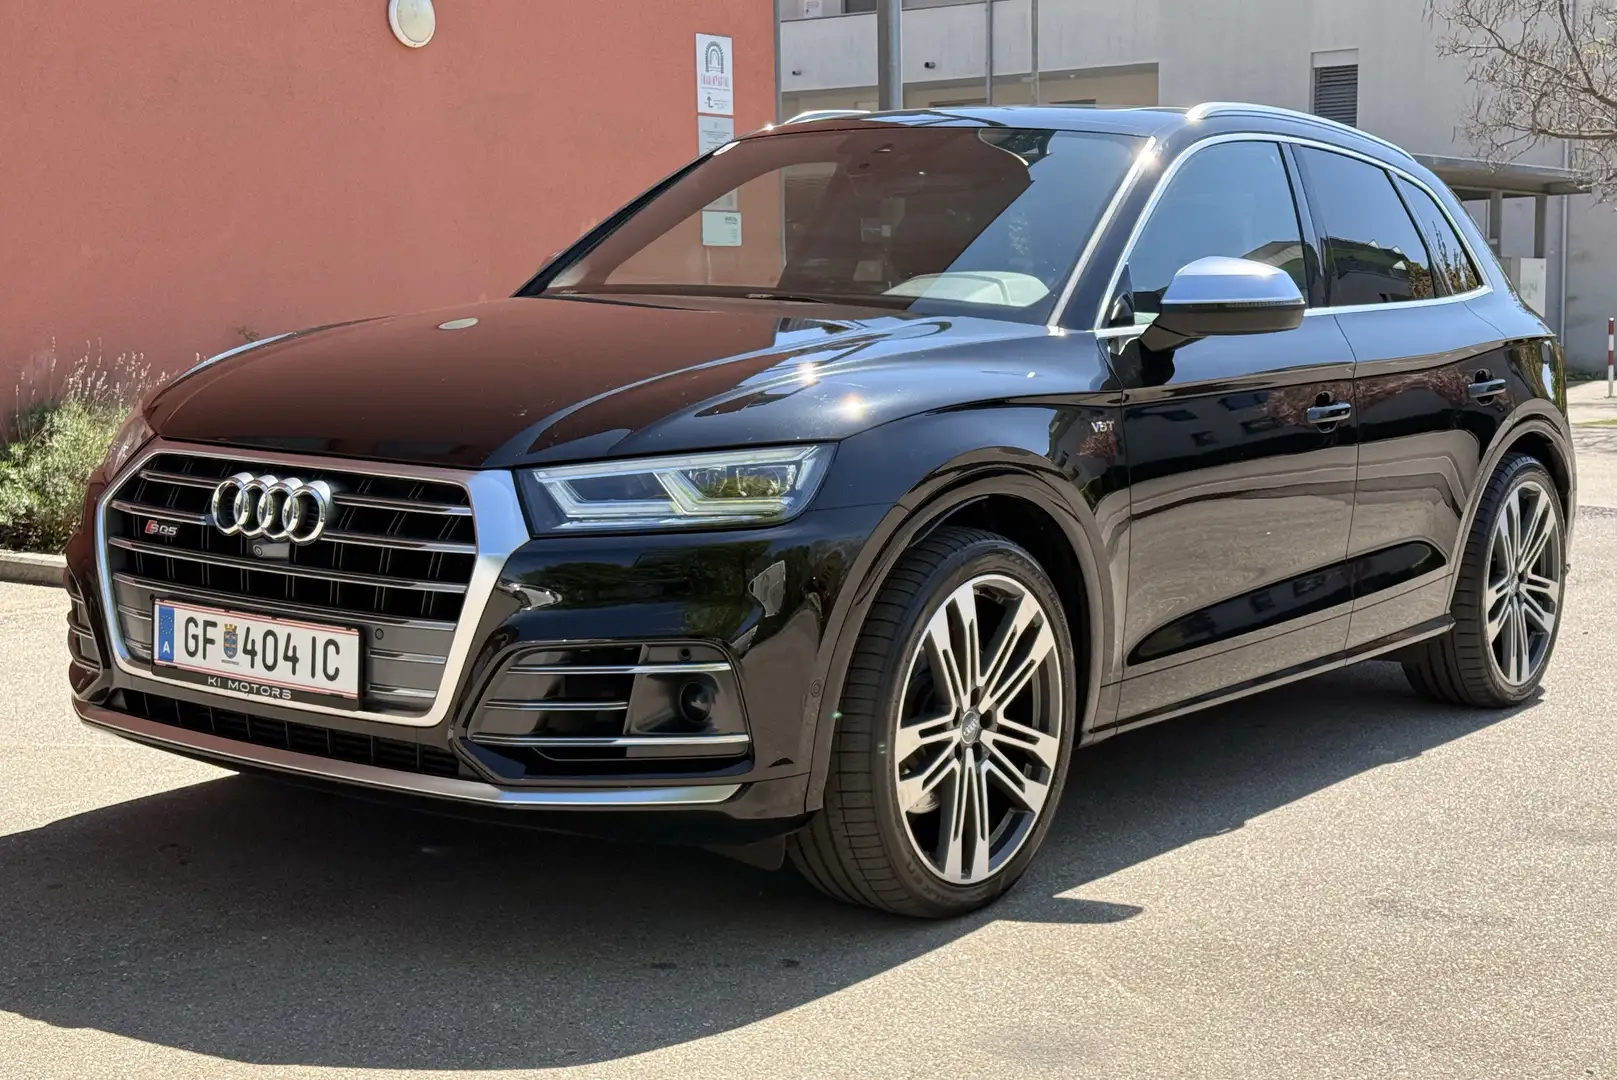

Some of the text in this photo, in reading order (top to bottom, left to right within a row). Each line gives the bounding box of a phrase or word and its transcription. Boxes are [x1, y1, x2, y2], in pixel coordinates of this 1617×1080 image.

[145, 519, 178, 536] SQ5
[162, 640, 171, 654] A
[184, 616, 341, 682] GF 404 IC
[207, 676, 292, 700] KI MOTORS
